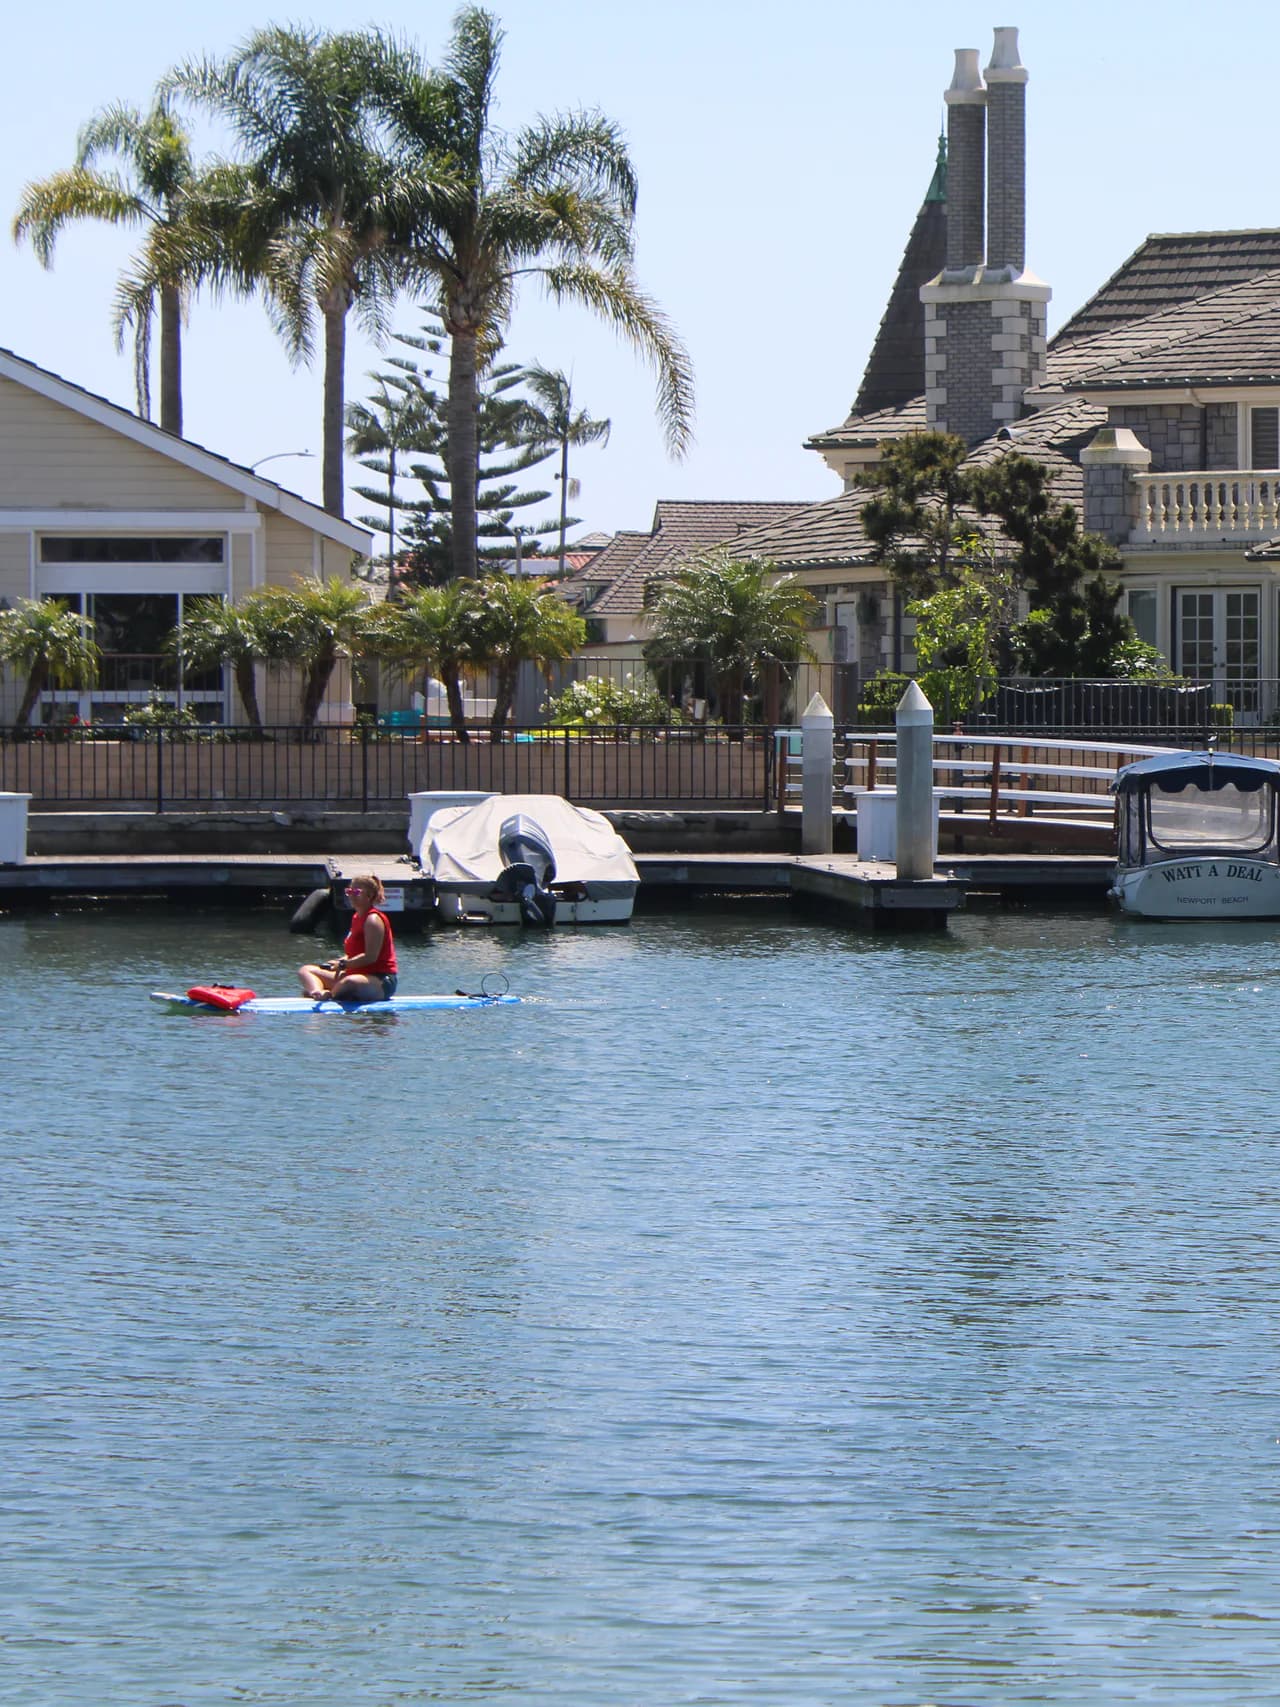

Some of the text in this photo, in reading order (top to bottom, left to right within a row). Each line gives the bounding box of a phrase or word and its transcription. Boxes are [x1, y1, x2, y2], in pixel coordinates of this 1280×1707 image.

[1162, 864, 1263, 882] WATT A DEAL
[1177, 896, 1249, 904] NEWPORT BEACH
